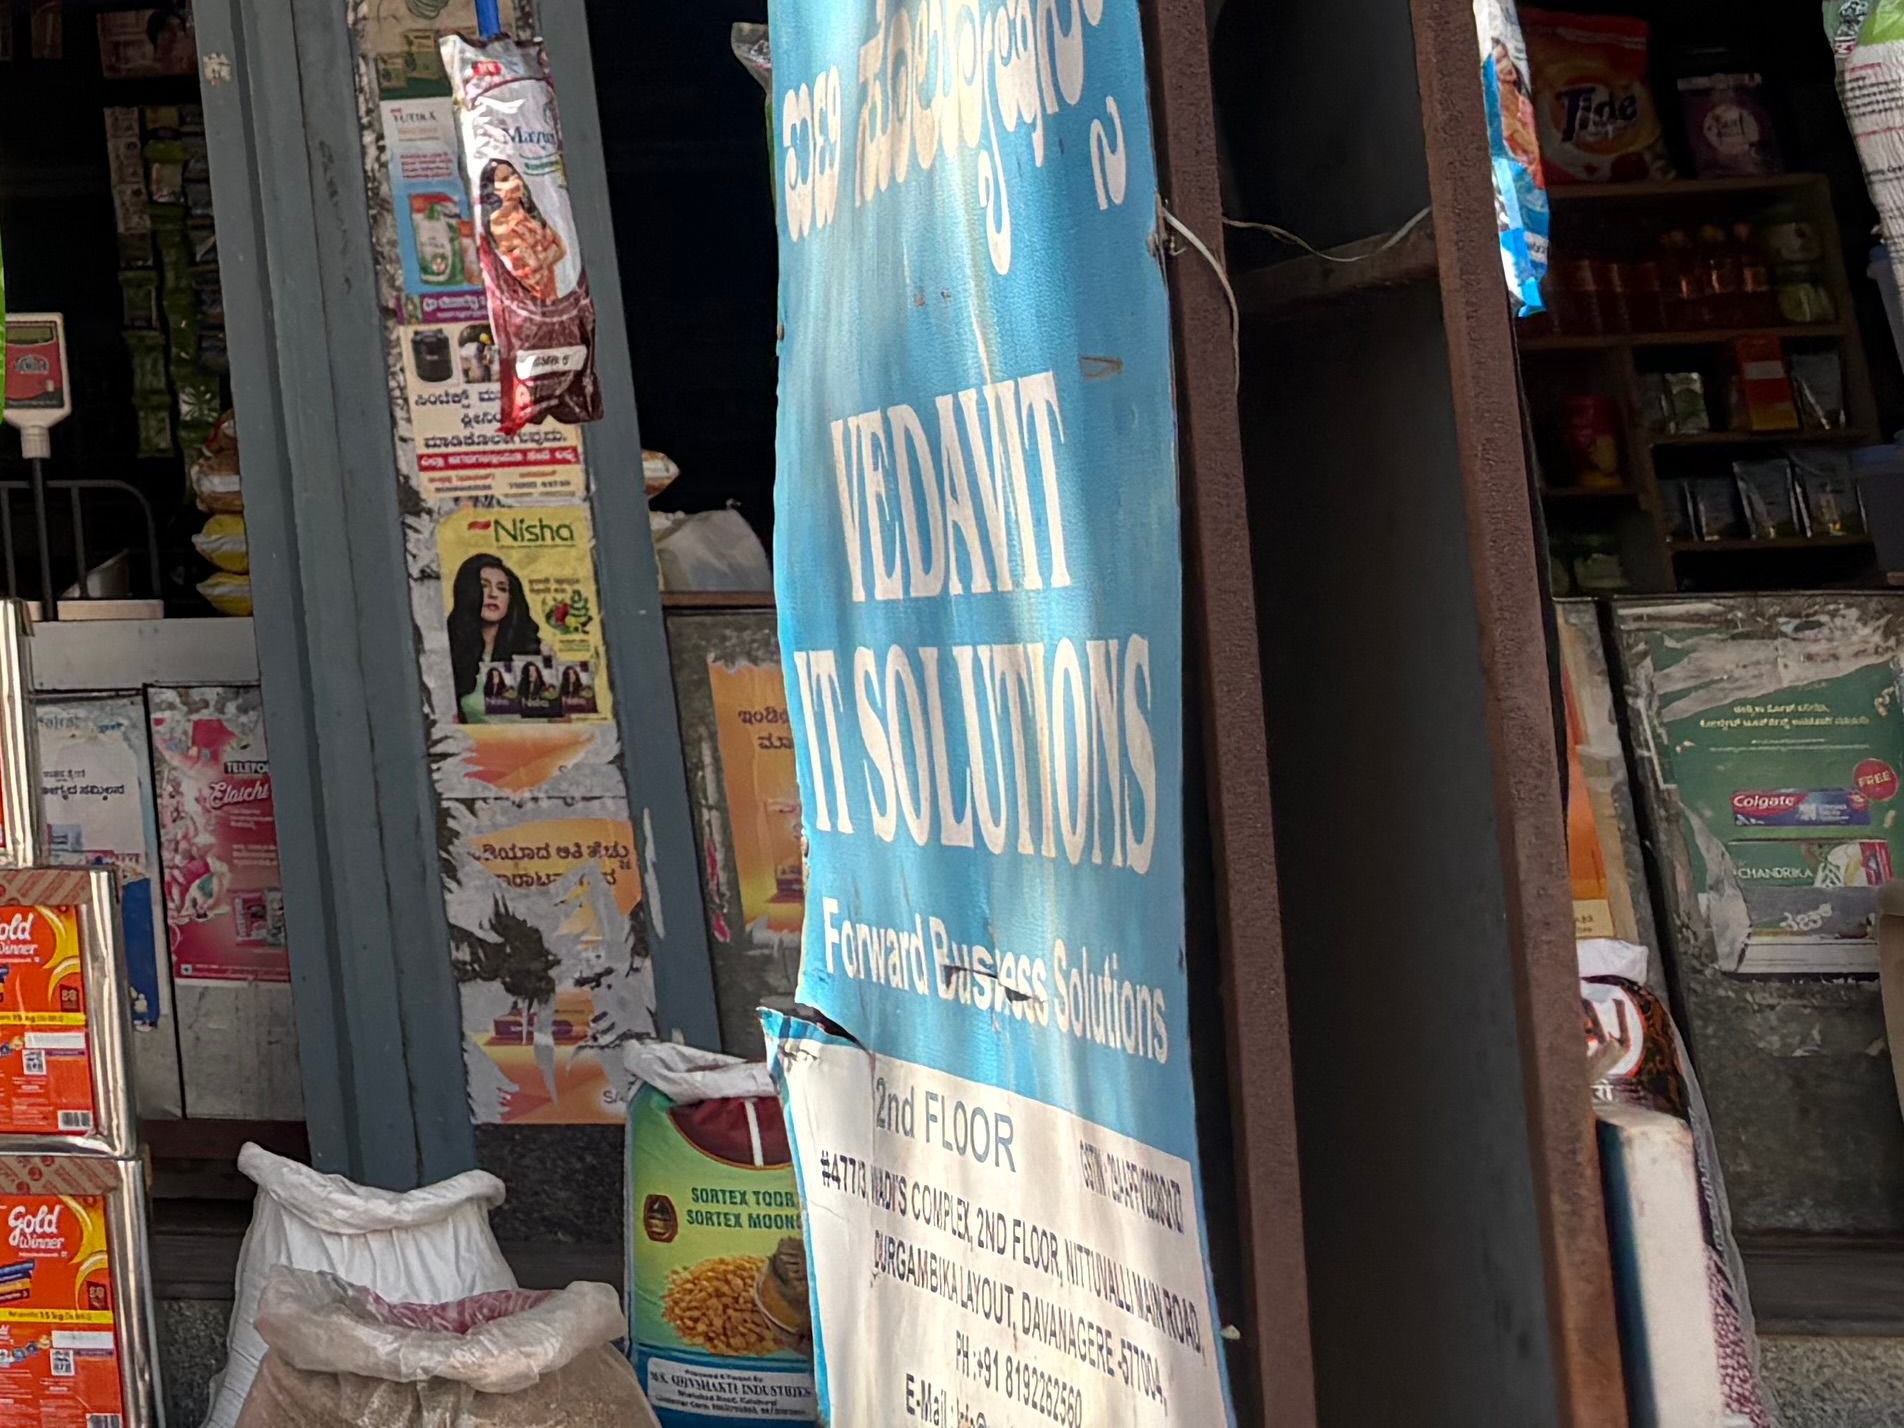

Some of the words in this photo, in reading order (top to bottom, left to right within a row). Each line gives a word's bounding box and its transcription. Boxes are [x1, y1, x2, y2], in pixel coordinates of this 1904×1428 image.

[1555, 84, 1638, 144] Tide
[830, 371, 1072, 603] VEDAVIT
[493, 517, 575, 543] Nisha
[793, 648, 854, 835] IT
[853, 633, 1158, 875] SOLUTIONS
[1856, 770, 1892, 789] FREE
[1732, 794, 1796, 810] Colgate
[1737, 865, 1814, 881] CHANDRIKA
[822, 896, 928, 996] Forward
[1052, 939, 1168, 1066] Solutions
[874, 1075, 915, 1139] 2nd
[925, 1091, 1017, 1173] FLOOR
[686, 1208, 744, 1229] SORTEX
[691, 1187, 749, 1208] SORTEX
[8, 1203, 60, 1248] Gold
[976, 1203, 1008, 1256] 2ND
[1011, 1218, 1064, 1287] FLOOR,
[1064, 1237, 1136, 1315] NITTUVALLI
[873, 1229, 959, 1302] DURGAMBIKA
[1020, 1292, 1116, 1377] DAVANAGERE
